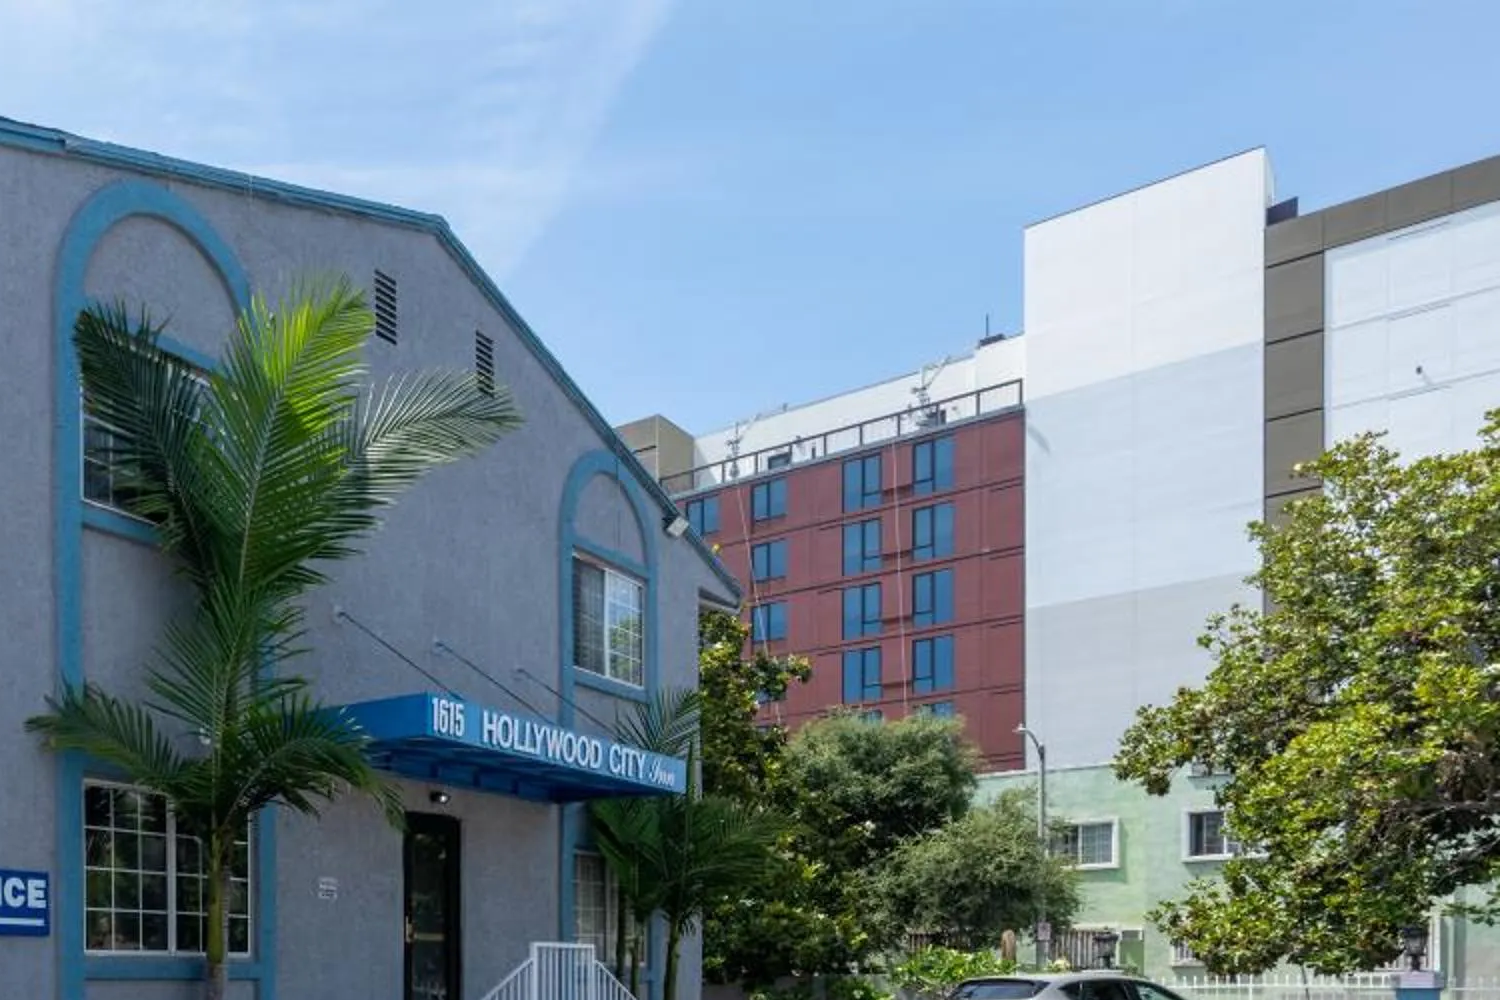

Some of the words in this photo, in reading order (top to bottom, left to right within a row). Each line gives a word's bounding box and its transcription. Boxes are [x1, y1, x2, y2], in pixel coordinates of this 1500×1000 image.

[432, 698, 465, 737] 1615
[483, 709, 602, 769] HOLLYWOOD
[609, 743, 645, 779] CITY
